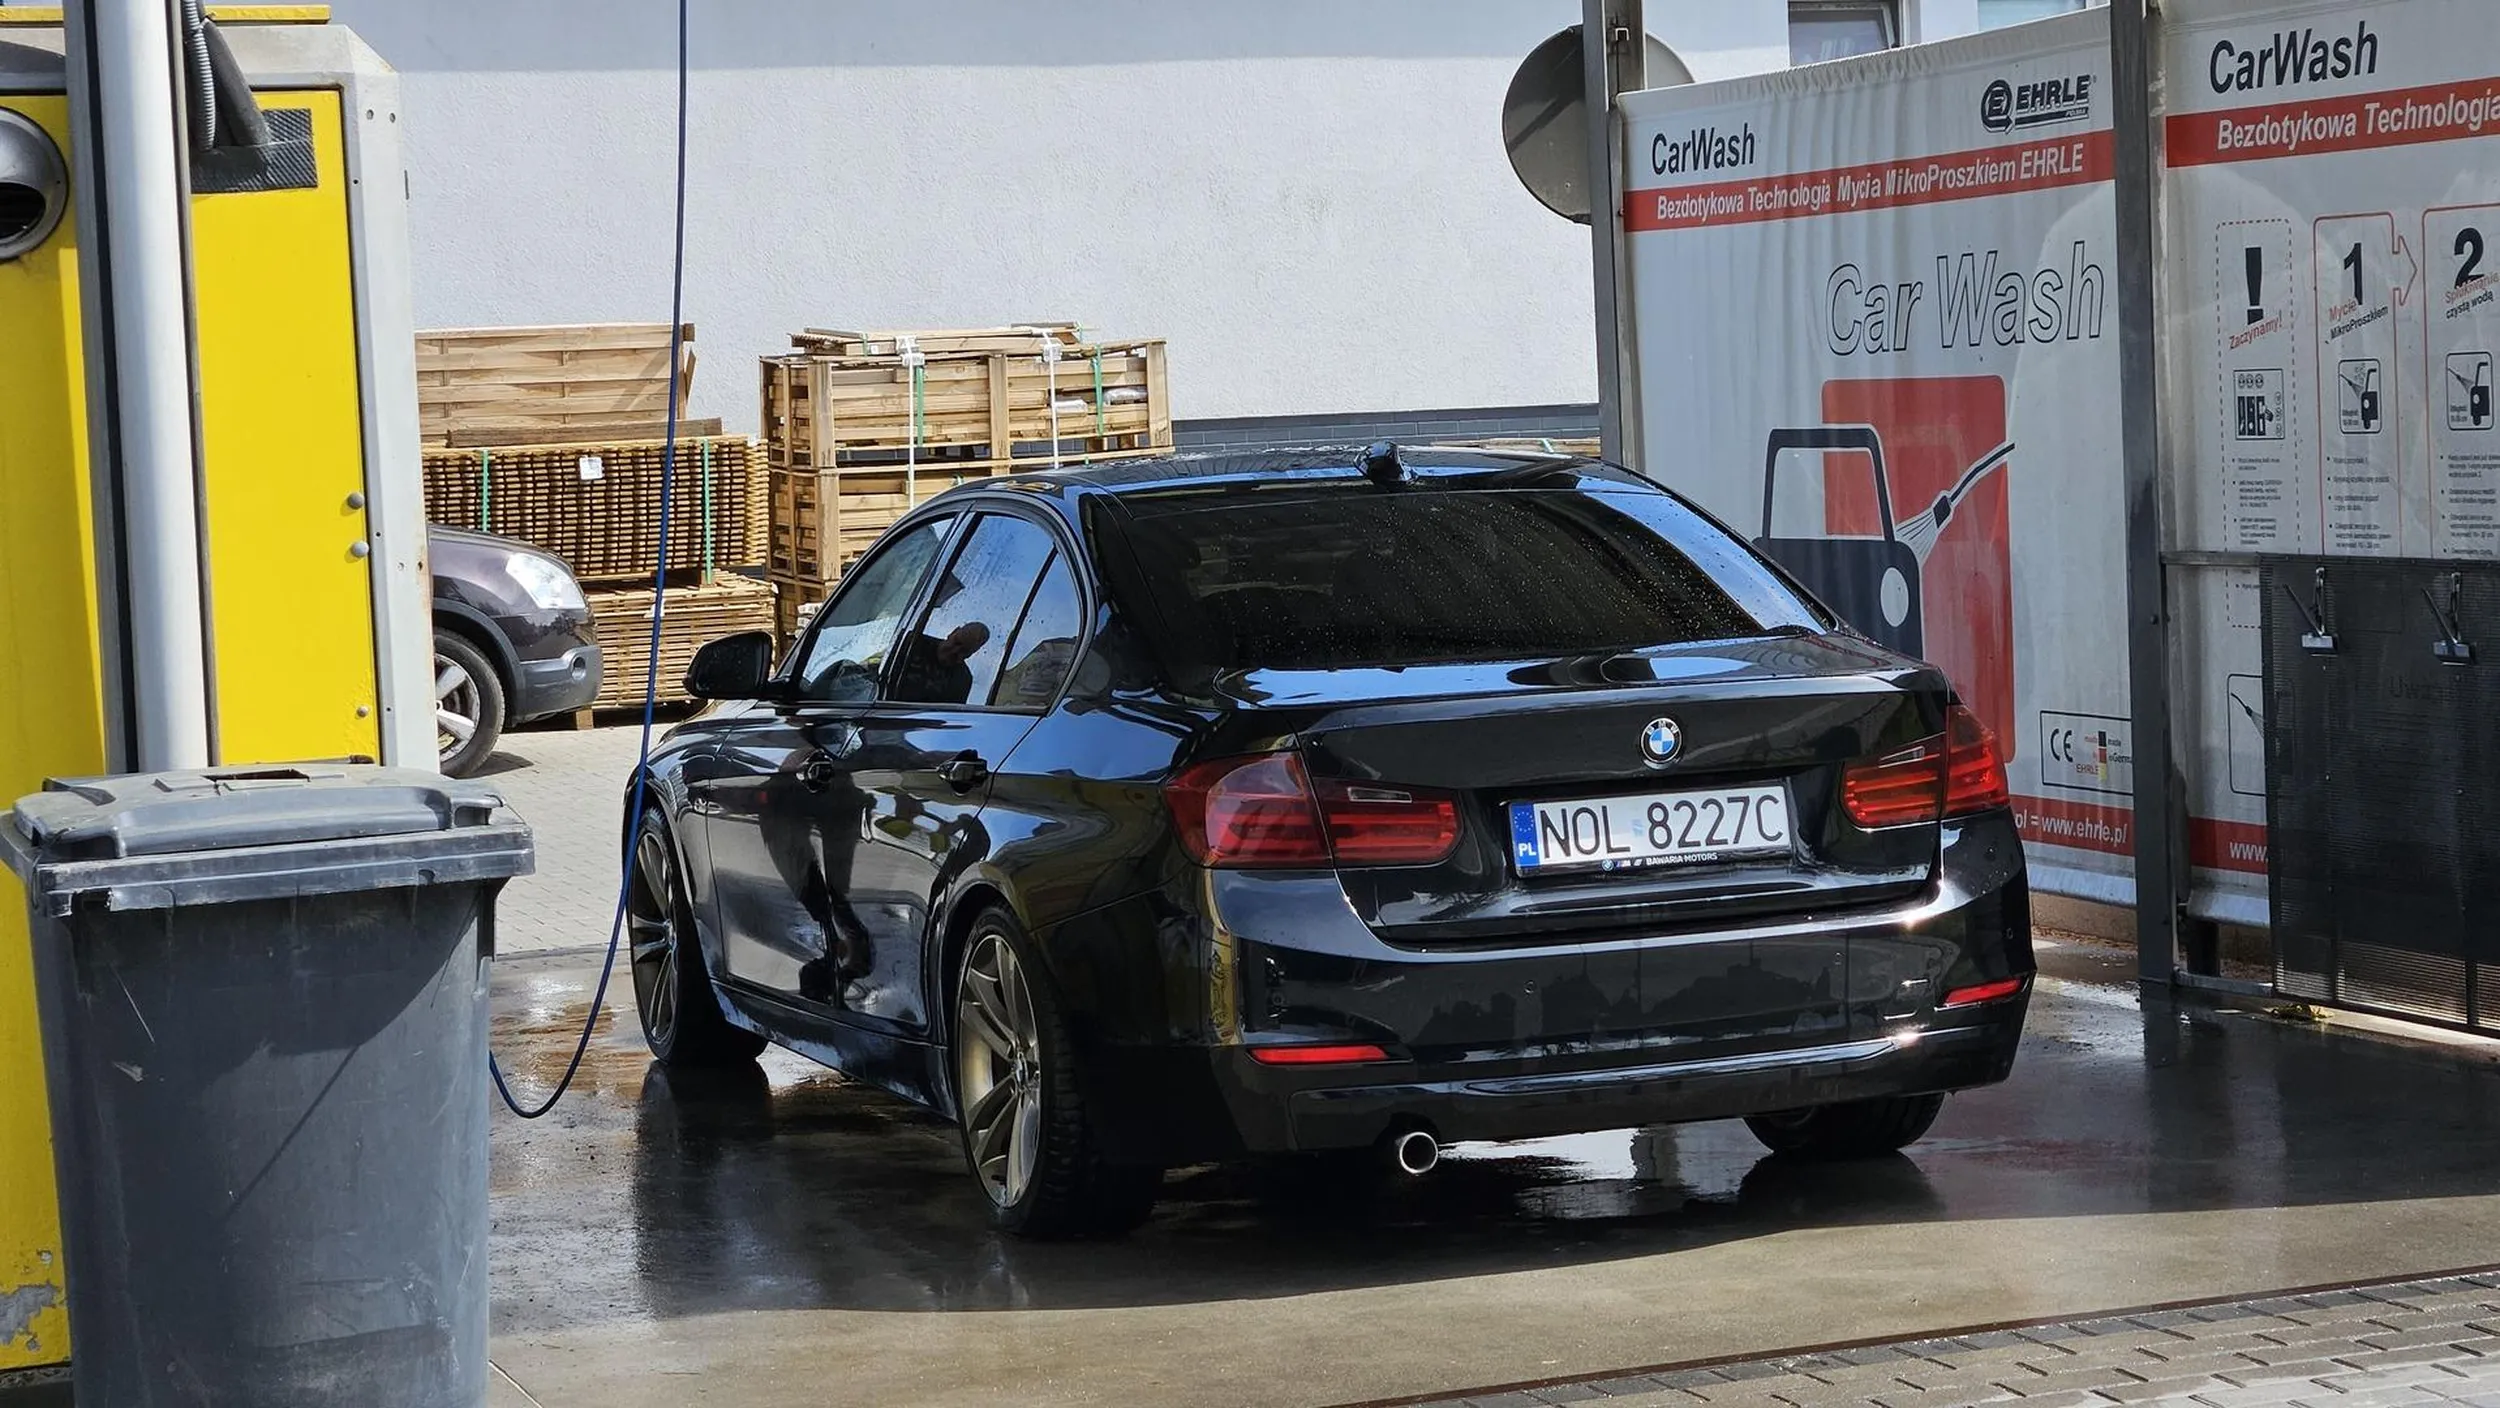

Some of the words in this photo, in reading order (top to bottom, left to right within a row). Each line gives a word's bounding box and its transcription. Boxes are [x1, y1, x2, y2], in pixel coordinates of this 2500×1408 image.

[2209, 20, 2379, 94] CarWash
[2016, 74, 2091, 114] EHRLE
[2217, 110, 2357, 151] Bezdotykowa
[2364, 88, 2500, 133] Technologia
[1652, 122, 1756, 176] CarWash
[1657, 191, 1744, 223] Bezdotykowa
[1748, 178, 1831, 211] Technologia
[1837, 174, 1881, 207] Mycia
[1885, 155, 2016, 197] MikroProszkiem
[2019, 143, 2084, 180] EHRLE
[2343, 242, 2364, 306] 1
[2454, 227, 2485, 289] 2
[1826, 263, 1923, 356] Car
[1936, 240, 2105, 348] Wash
[1518, 843, 1537, 857] PL
[1540, 804, 1631, 859] NOL
[1646, 794, 1784, 850] 8227C
[2041, 815, 2127, 847] www.ehrle.pl
[1646, 855, 1683, 866] BAWARIA
[1683, 852, 1718, 863] MOTORS
